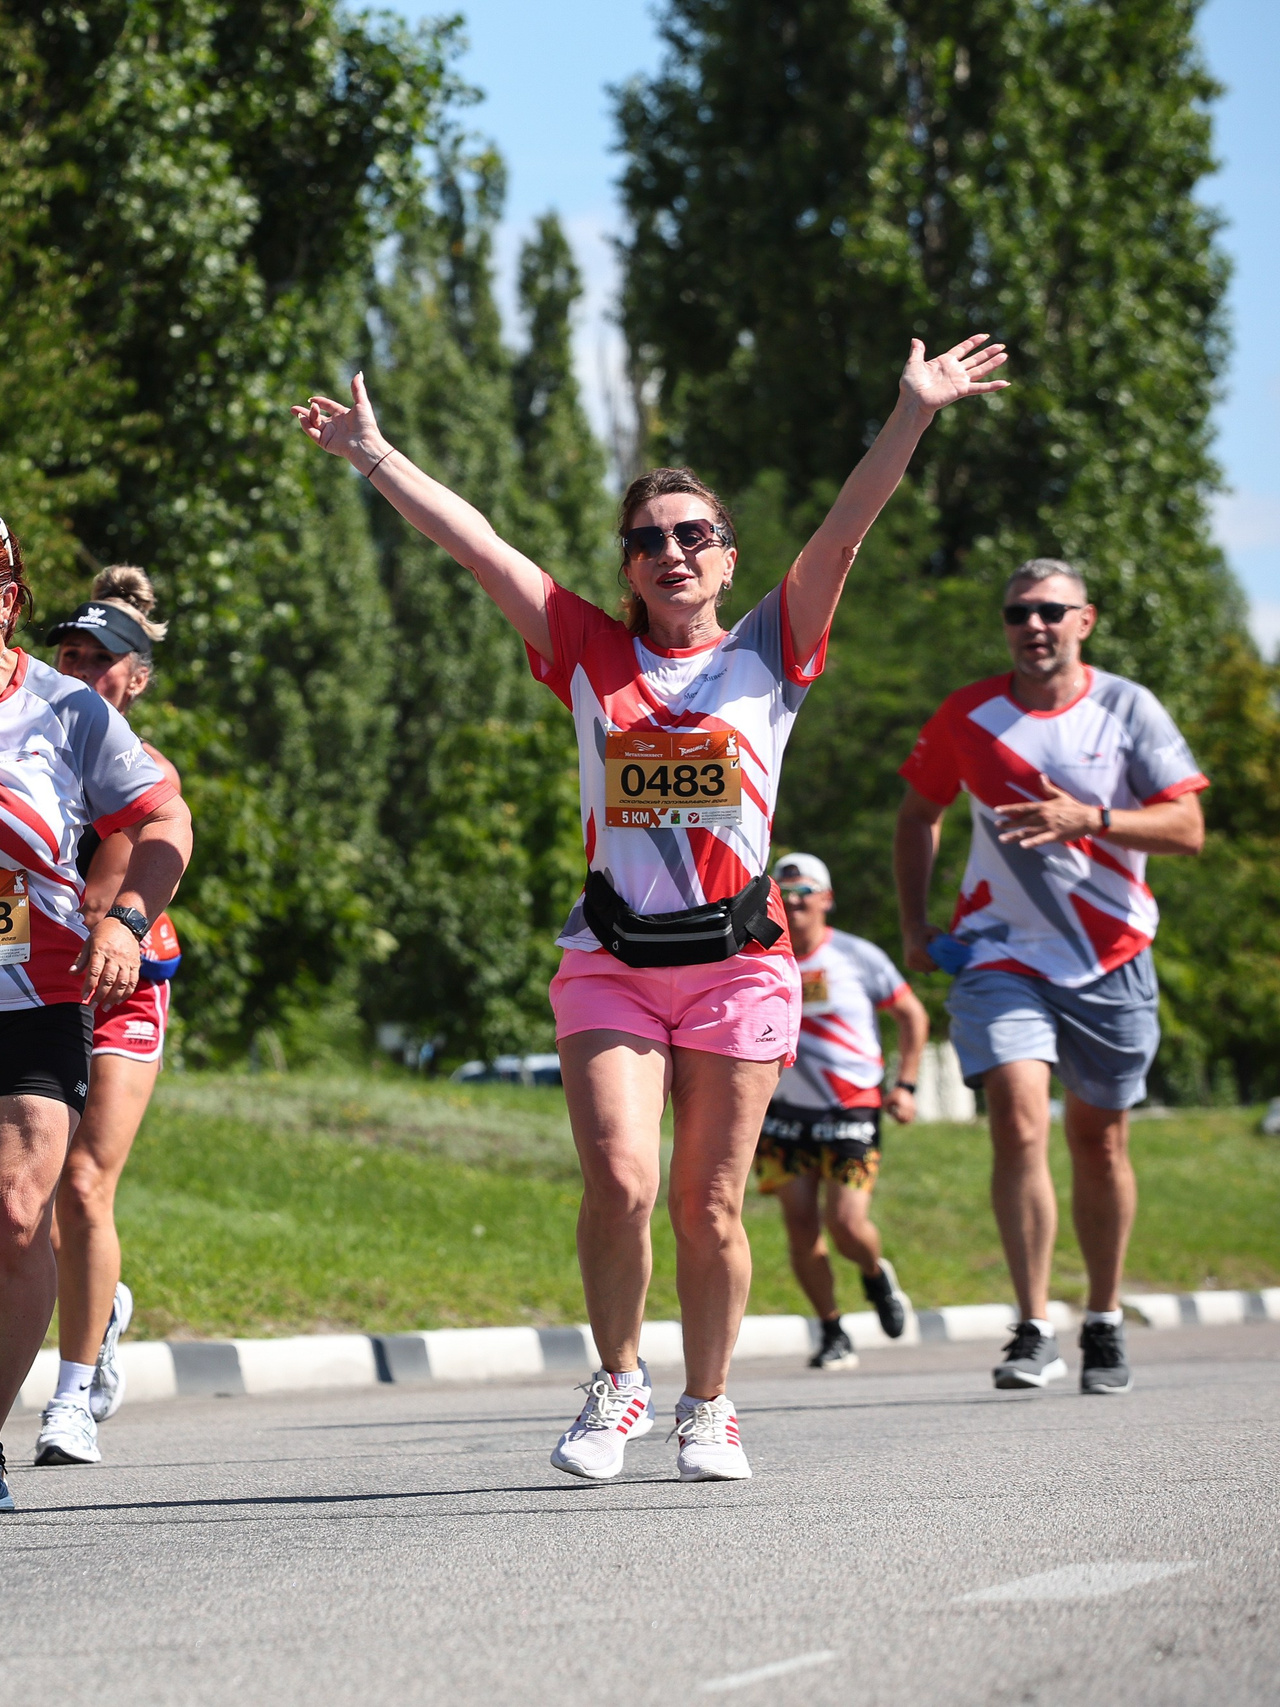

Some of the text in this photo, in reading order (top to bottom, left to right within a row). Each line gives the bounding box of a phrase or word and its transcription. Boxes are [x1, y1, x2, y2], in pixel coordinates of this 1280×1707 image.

[78, 615, 107, 626] adidas
[620, 764, 725, 797] 0483
[622, 811, 628, 824] 5
